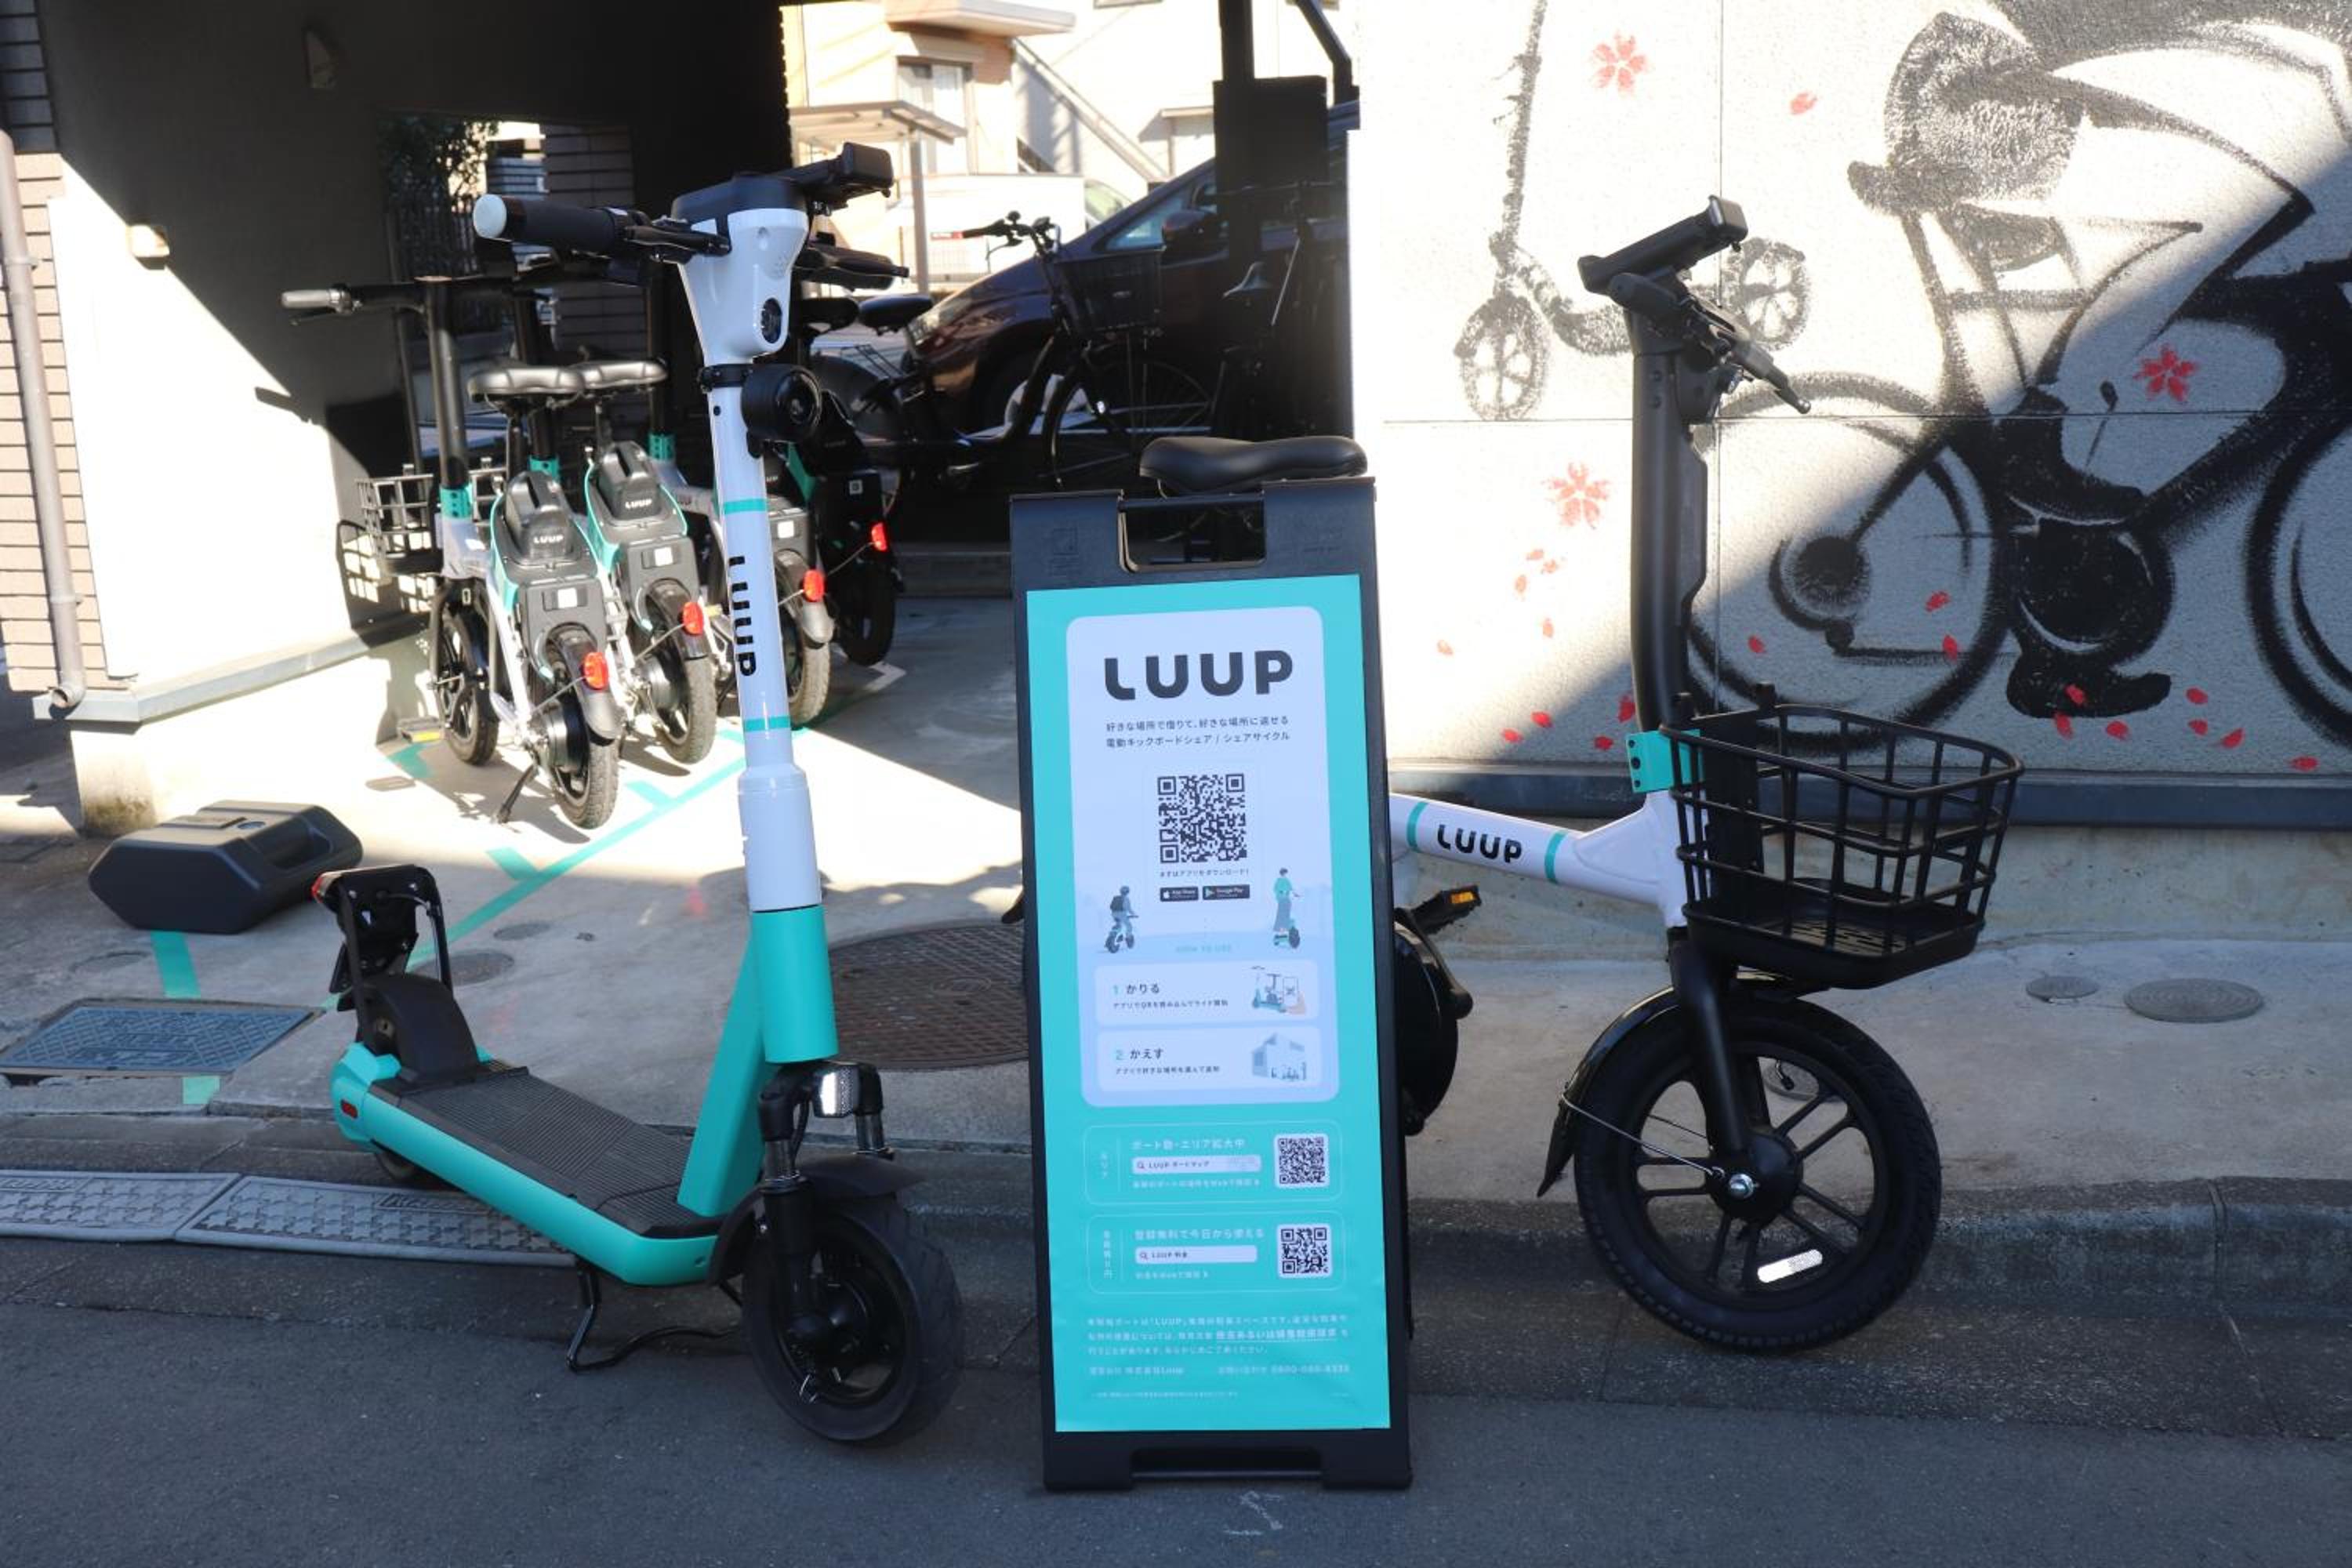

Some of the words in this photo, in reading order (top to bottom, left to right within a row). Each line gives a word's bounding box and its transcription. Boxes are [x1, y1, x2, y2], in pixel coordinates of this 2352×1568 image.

[626, 499, 652, 509] LUUP
[533, 535, 564, 544] LUUP
[1104, 649, 1294, 700] LUUP
[1437, 824, 1523, 863] LUUP
[1127, 983, 1160, 995] かりる
[1130, 1047, 1164, 1059] かえす
